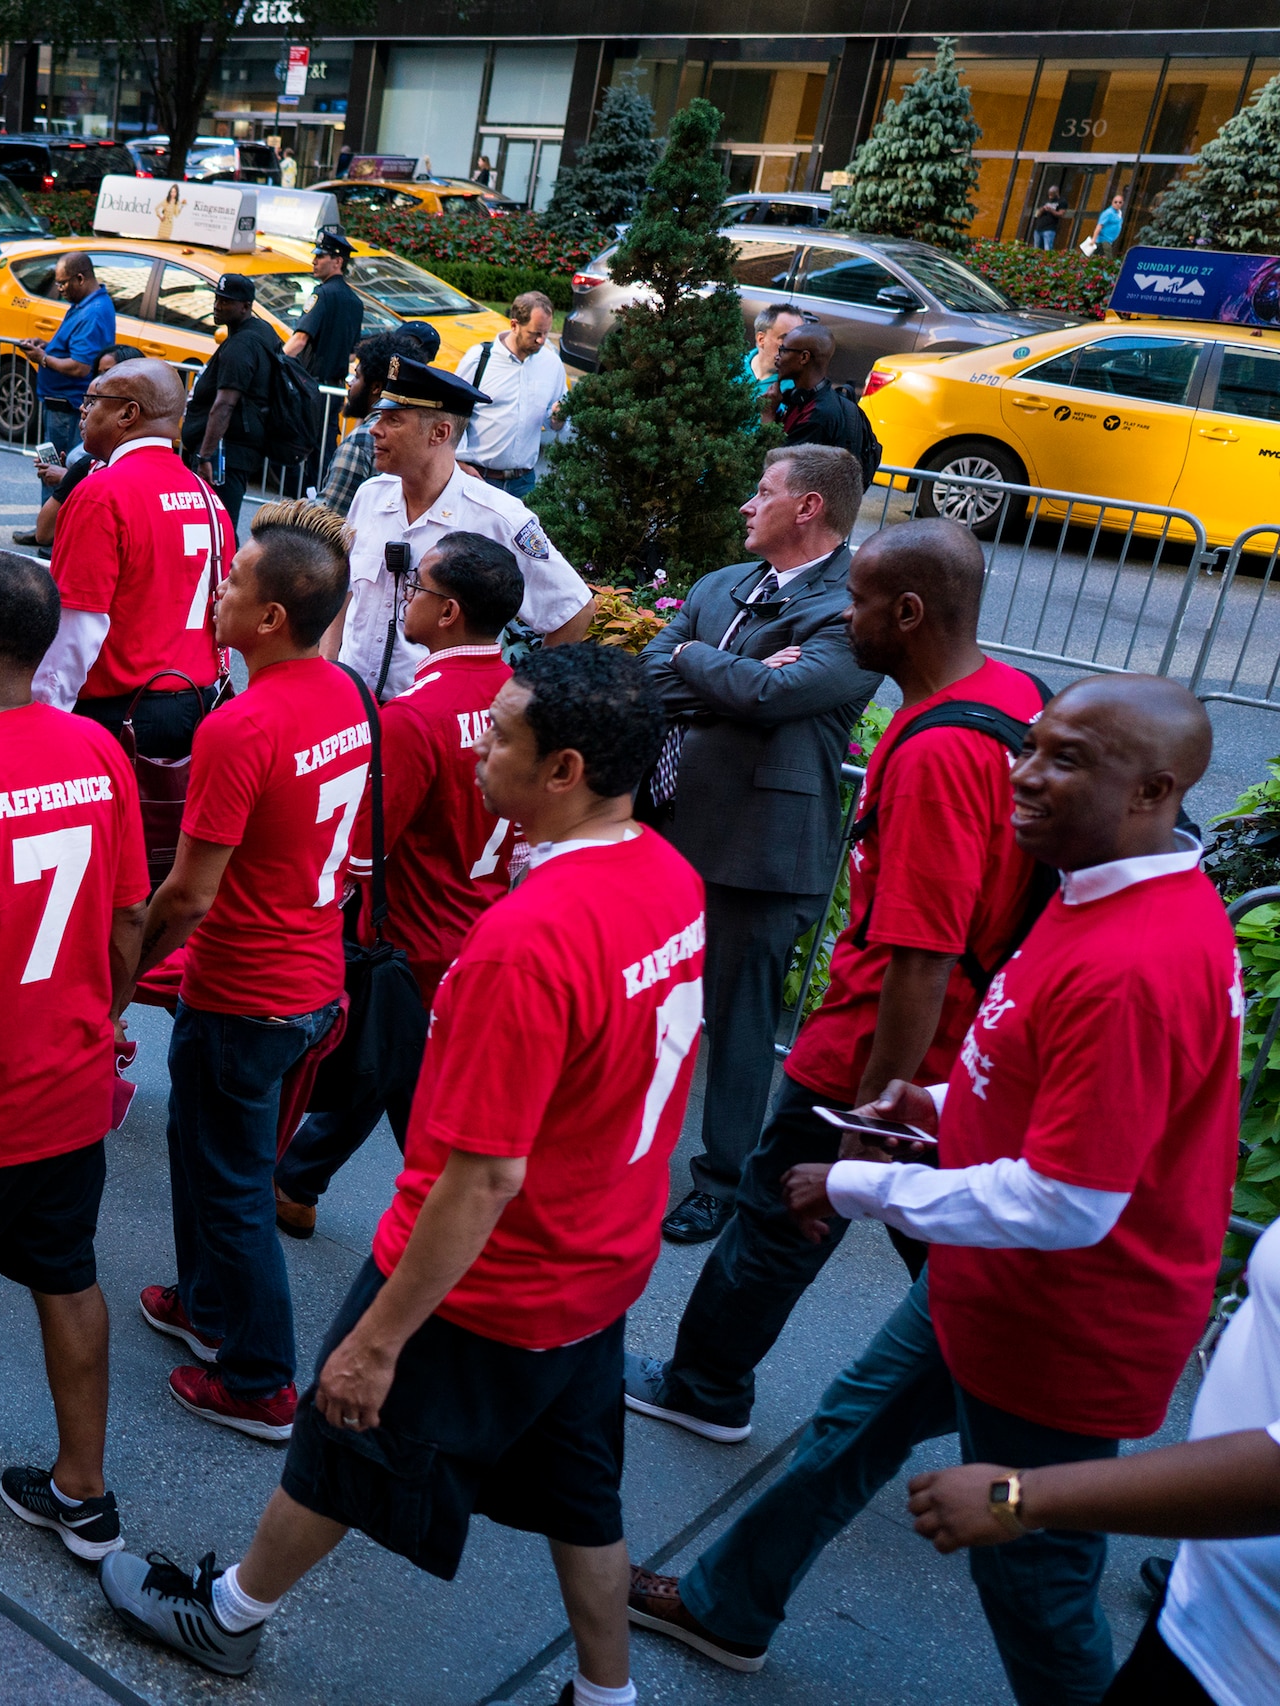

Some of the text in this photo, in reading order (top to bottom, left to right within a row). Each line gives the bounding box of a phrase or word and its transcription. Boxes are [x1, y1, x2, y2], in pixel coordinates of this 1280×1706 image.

[1061, 118, 1108, 138] 350
[101, 193, 152, 215] Deluded.
[193, 200, 236, 216] Kingsman
[1136, 262, 1214, 276] SUNDAY AUG 27
[313, 762, 369, 907] 7
[13, 825, 92, 984] 7
[627, 976, 703, 1165] 7
